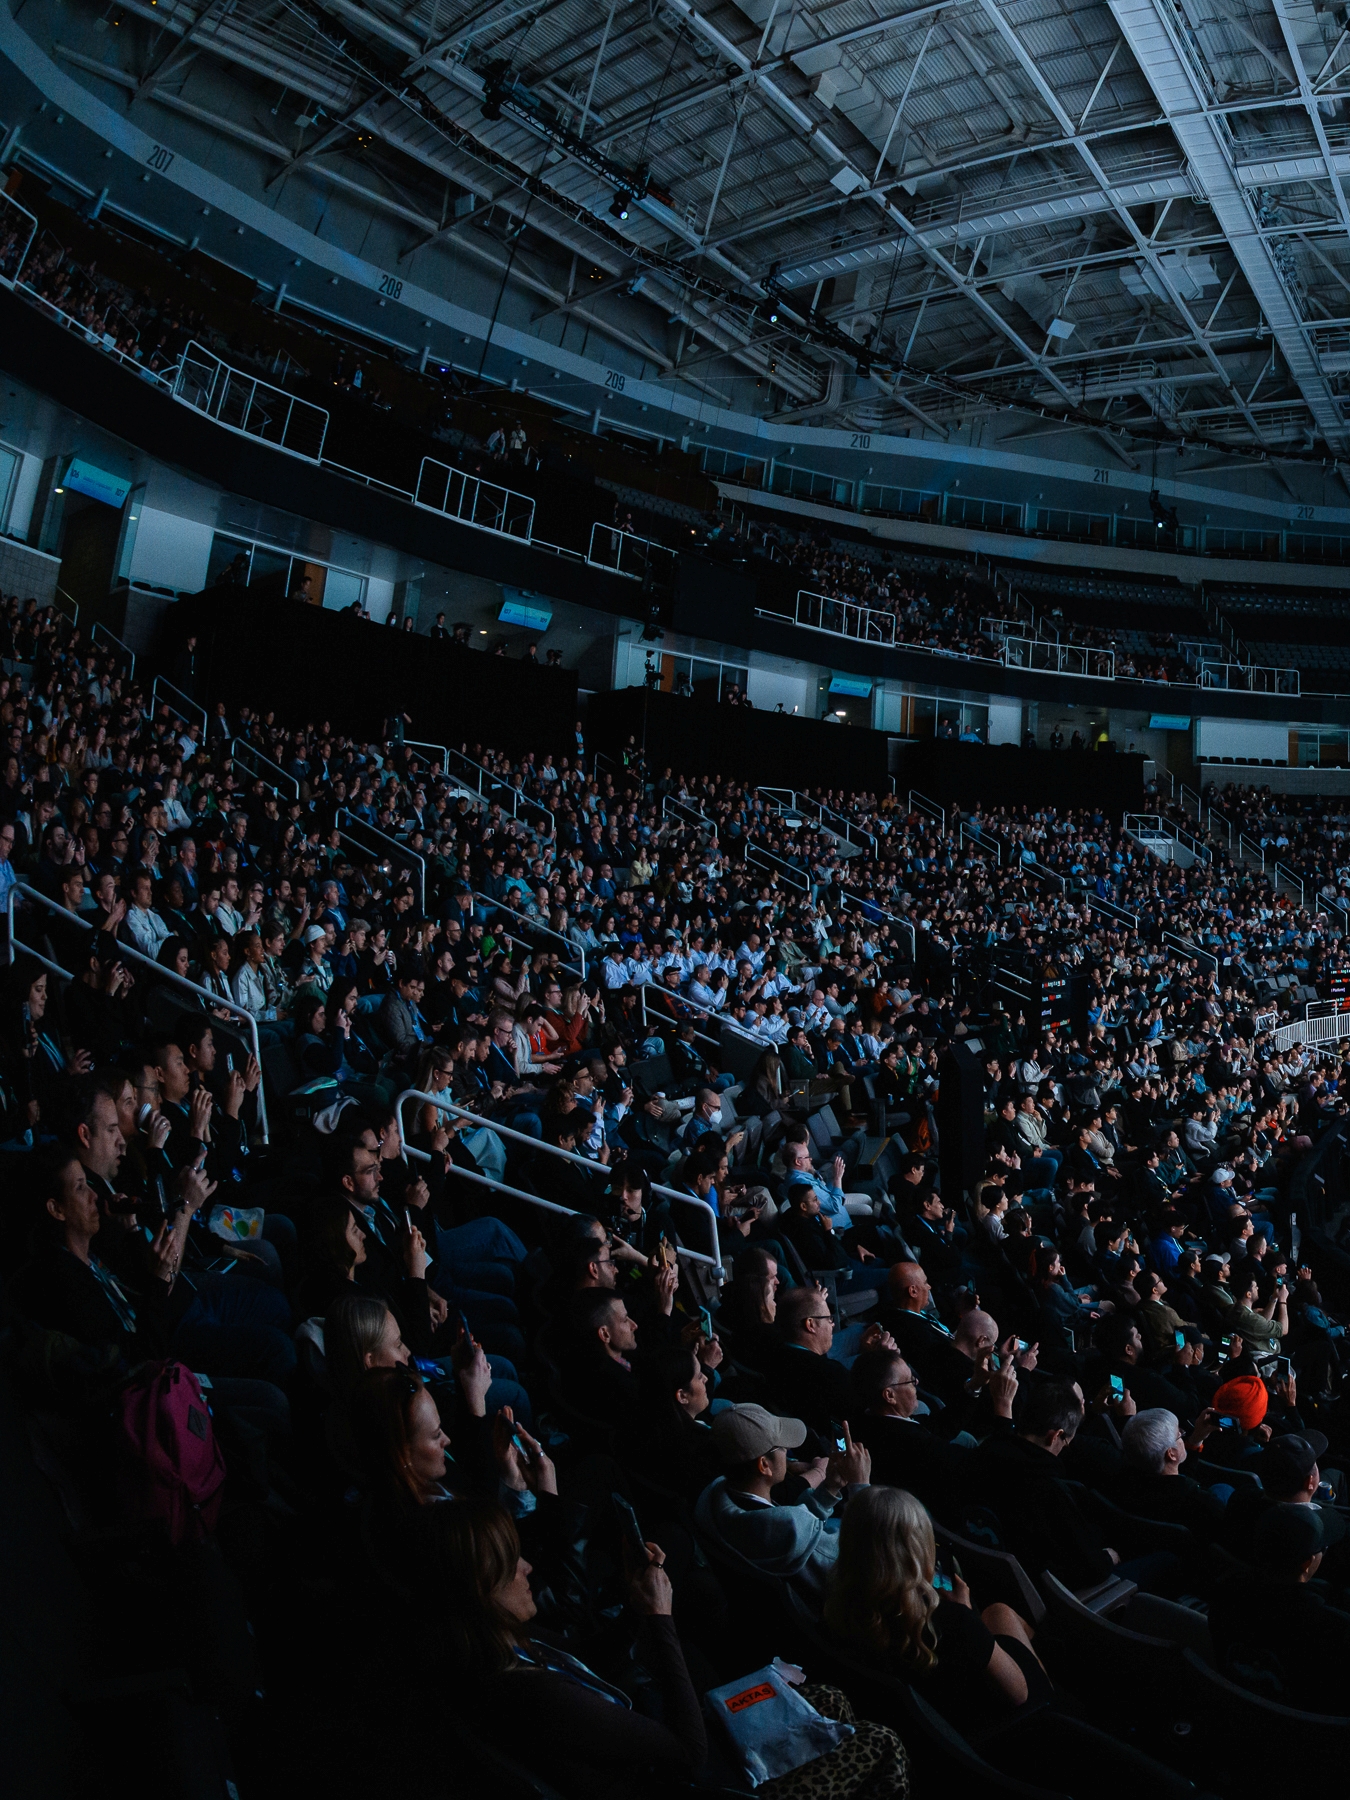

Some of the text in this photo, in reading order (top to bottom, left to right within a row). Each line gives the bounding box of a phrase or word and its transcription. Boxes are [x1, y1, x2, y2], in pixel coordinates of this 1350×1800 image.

[147, 145, 175, 173] 207
[379, 274, 403, 300] 208
[605, 370, 625, 391] 209
[850, 433, 870, 449] 210
[1093, 468, 1109, 484] 211
[1297, 505, 1315, 520] 212
[731, 1687, 771, 1709] AKTAS
